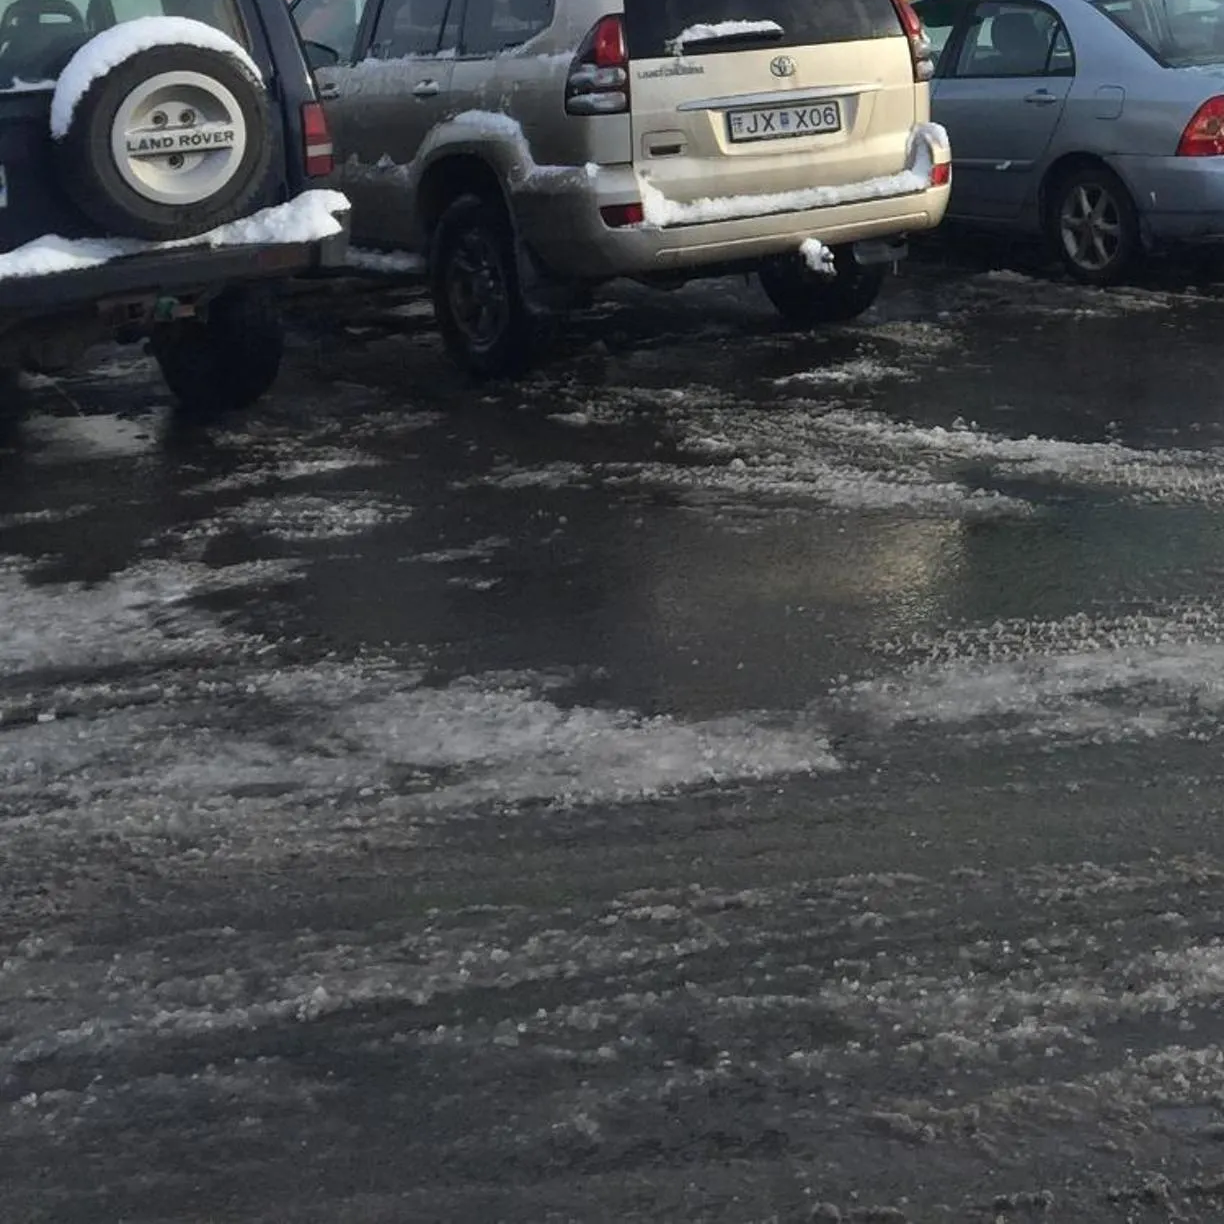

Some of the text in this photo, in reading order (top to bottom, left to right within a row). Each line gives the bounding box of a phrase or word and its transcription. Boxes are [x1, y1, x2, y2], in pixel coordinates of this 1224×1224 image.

[746, 111, 776, 134] JX
[794, 107, 836, 127] X06
[127, 130, 234, 152] LAND ROVER
